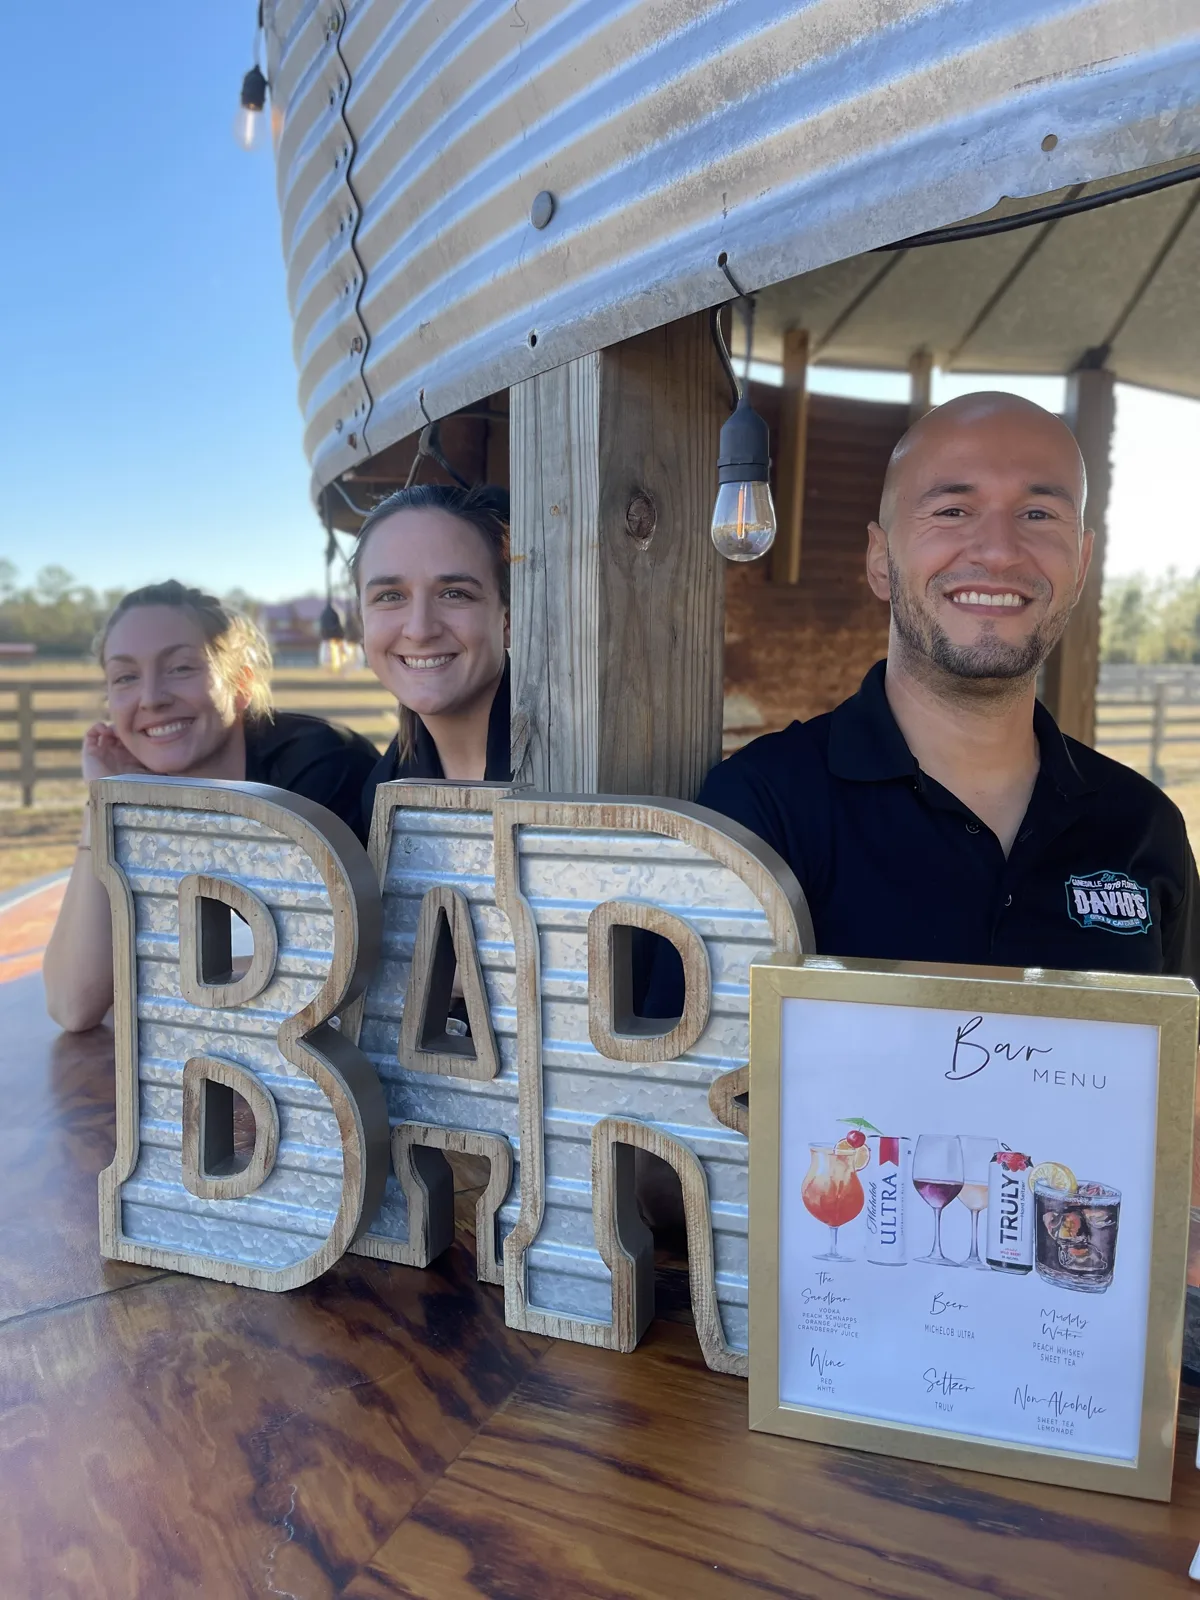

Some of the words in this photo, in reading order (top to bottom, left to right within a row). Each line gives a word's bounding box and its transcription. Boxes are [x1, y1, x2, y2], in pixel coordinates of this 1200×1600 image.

[1104, 881, 1121, 890] 1978
[1073, 889, 1147, 919] DAVID'S
[945, 1016, 1052, 1080] Bar
[91, 777, 811, 1376] BAR
[1033, 1069, 1107, 1089] MENU
[881, 1173, 897, 1245] ULTRA
[1000, 1173, 1018, 1244] TRULY
[815, 1271, 834, 1286] The
[801, 1288, 850, 1305] Sandbar
[930, 1292, 968, 1315] Beer
[805, 1319, 830, 1327] ORANGE
[833, 1322, 851, 1330] JUICE
[825, 1314, 857, 1324] SCHNAPPS
[1040, 1308, 1088, 1329] Muddy
[841, 1330, 859, 1338] JUICE
[924, 1324, 954, 1337] MICHELOB
[957, 1330, 975, 1340] ULTRA
[1033, 1342, 1053, 1352] PEACH
[1056, 1346, 1085, 1358] WHISKEY
[810, 1347, 845, 1376] Wine
[1041, 1353, 1060, 1364] SWEET
[1064, 1357, 1076, 1367] TEA
[817, 1385, 835, 1393] WHITE
[820, 1377, 833, 1385] RED
[923, 1367, 975, 1395] Seltzer
[935, 1401, 954, 1412] TRULY
[1037, 1416, 1058, 1425] SWEET
[1062, 1420, 1075, 1428] TEA
[1037, 1424, 1074, 1436] LEMONADE
